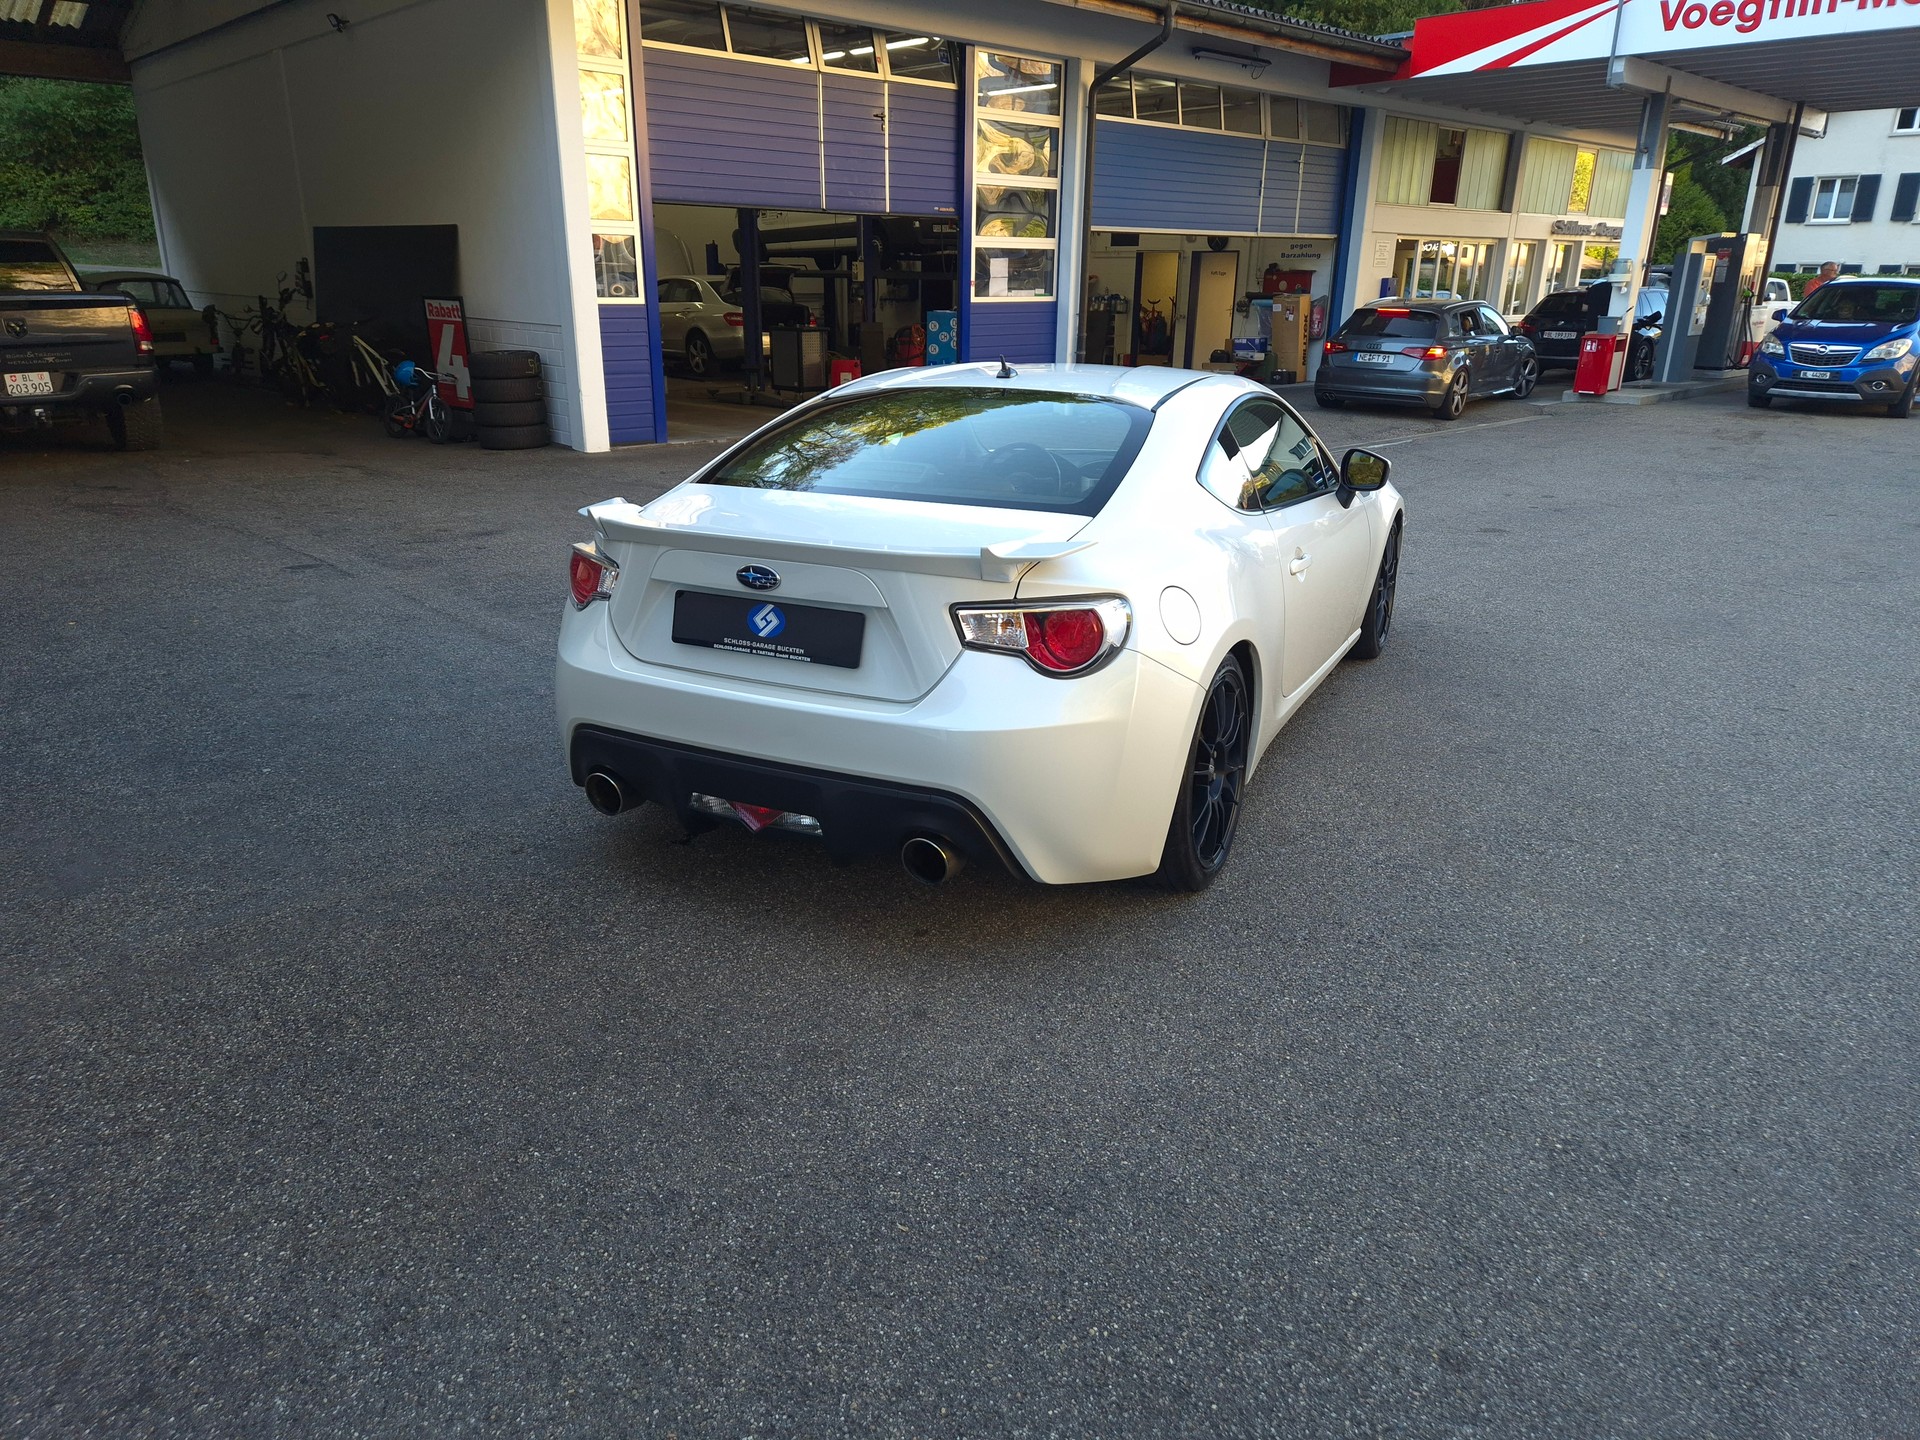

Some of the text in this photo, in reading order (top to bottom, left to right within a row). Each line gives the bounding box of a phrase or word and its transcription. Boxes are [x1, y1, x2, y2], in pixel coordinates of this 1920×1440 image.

[427, 302, 461, 318] Rabatt
[940, 333, 947, 341] CH
[22, 374, 33, 382] BL
[713, 643, 751, 653] SCHLOSS-GARAGE
[723, 637, 805, 654] SCHLOSS-GARAGE BUCKTEN
